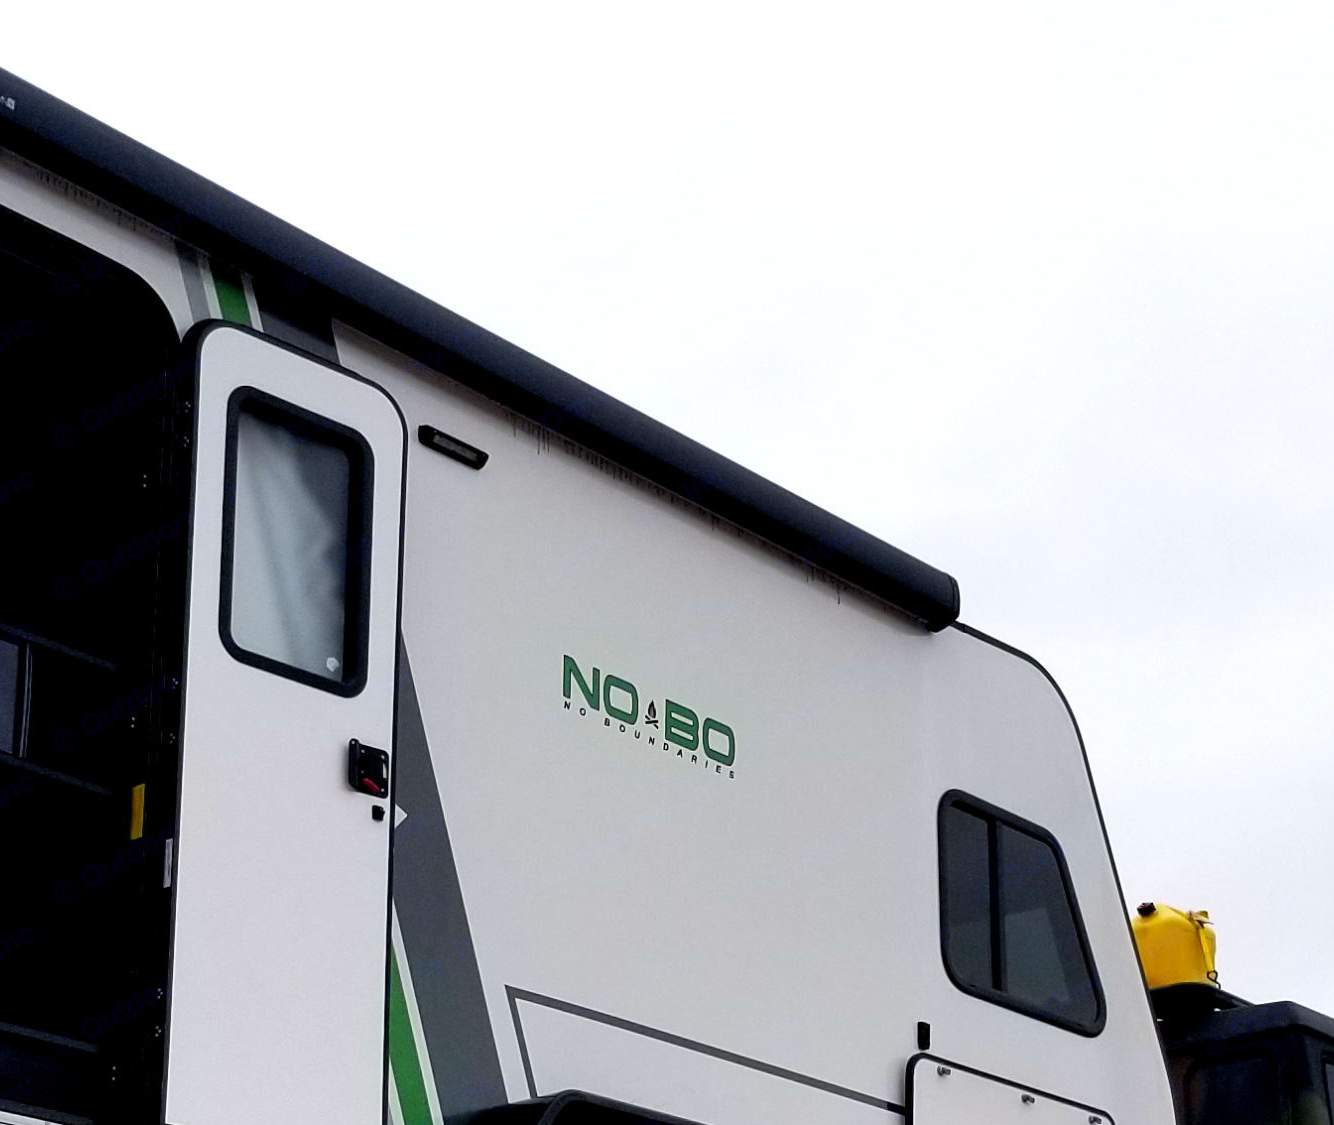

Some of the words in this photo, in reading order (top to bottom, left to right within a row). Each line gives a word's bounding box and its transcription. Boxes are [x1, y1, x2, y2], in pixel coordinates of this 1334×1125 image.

[562, 654, 639, 726] NO
[664, 698, 736, 767] BO
[563, 701, 587, 717] NO
[603, 717, 735, 779] BOUNDARIES
